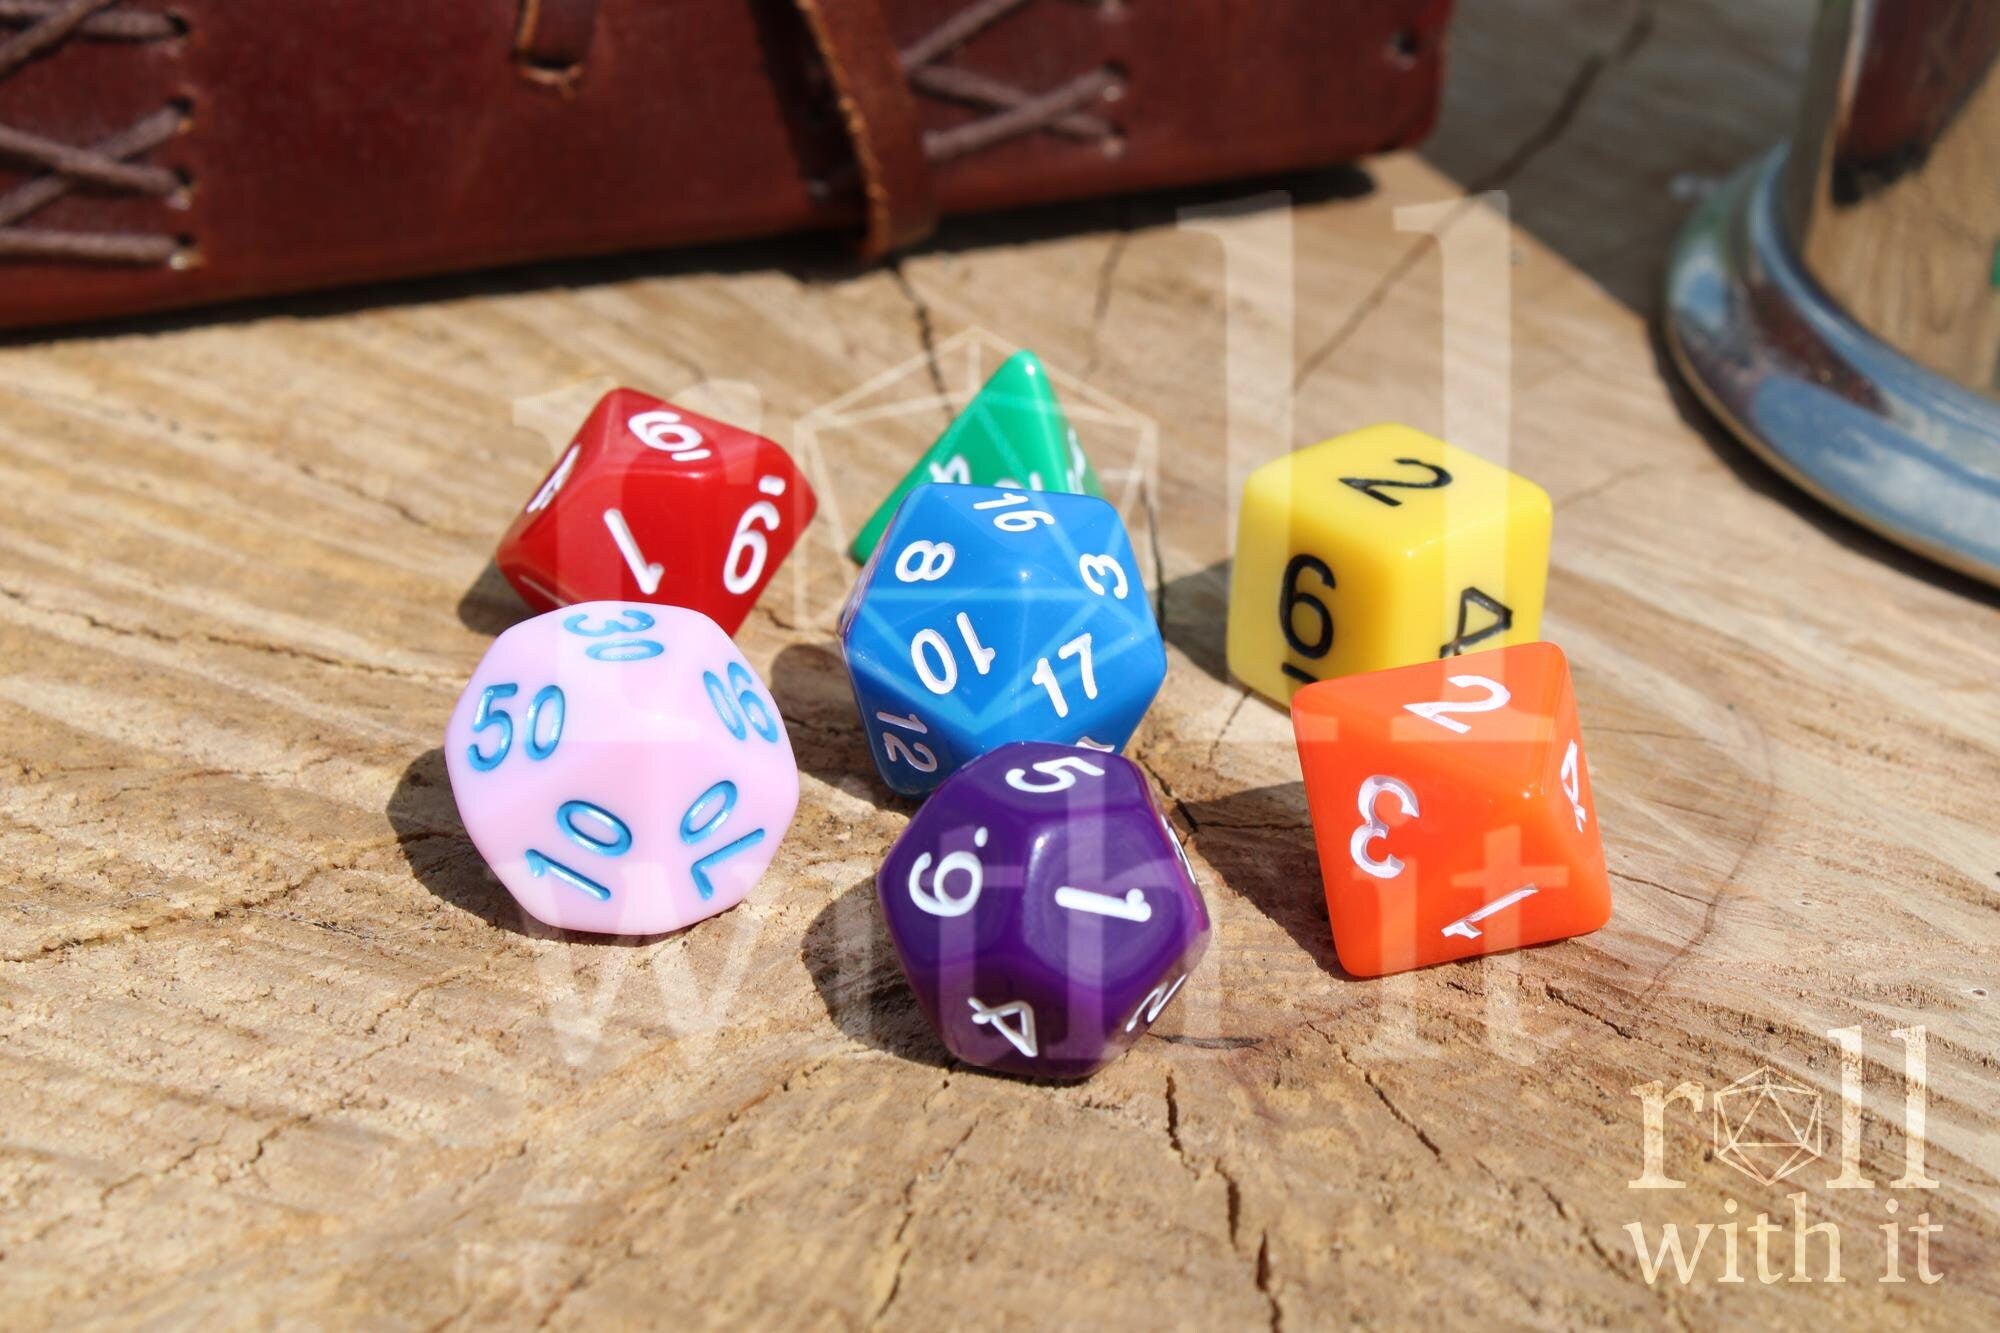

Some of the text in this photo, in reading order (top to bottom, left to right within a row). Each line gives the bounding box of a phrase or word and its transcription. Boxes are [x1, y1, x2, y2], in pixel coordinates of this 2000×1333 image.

[1338, 457, 1453, 507] 2
[603, 508, 664, 595] 1
[895, 540, 955, 582] 8
[1079, 553, 1128, 600] 3
[563, 610, 664, 661] 30
[911, 612, 995, 694] 10
[1032, 632, 1098, 718] 17
[1403, 675, 1511, 733] 2
[467, 682, 566, 772] 50
[876, 711, 937, 773] 12
[1006, 757, 1105, 793] 5
[1560, 739, 1586, 832] 4
[525, 800, 632, 901] 10
[1350, 774, 1419, 879] 3
[1055, 886, 1152, 922] 1
[1441, 883, 1539, 940] 1
[967, 997, 1038, 1057] 4
